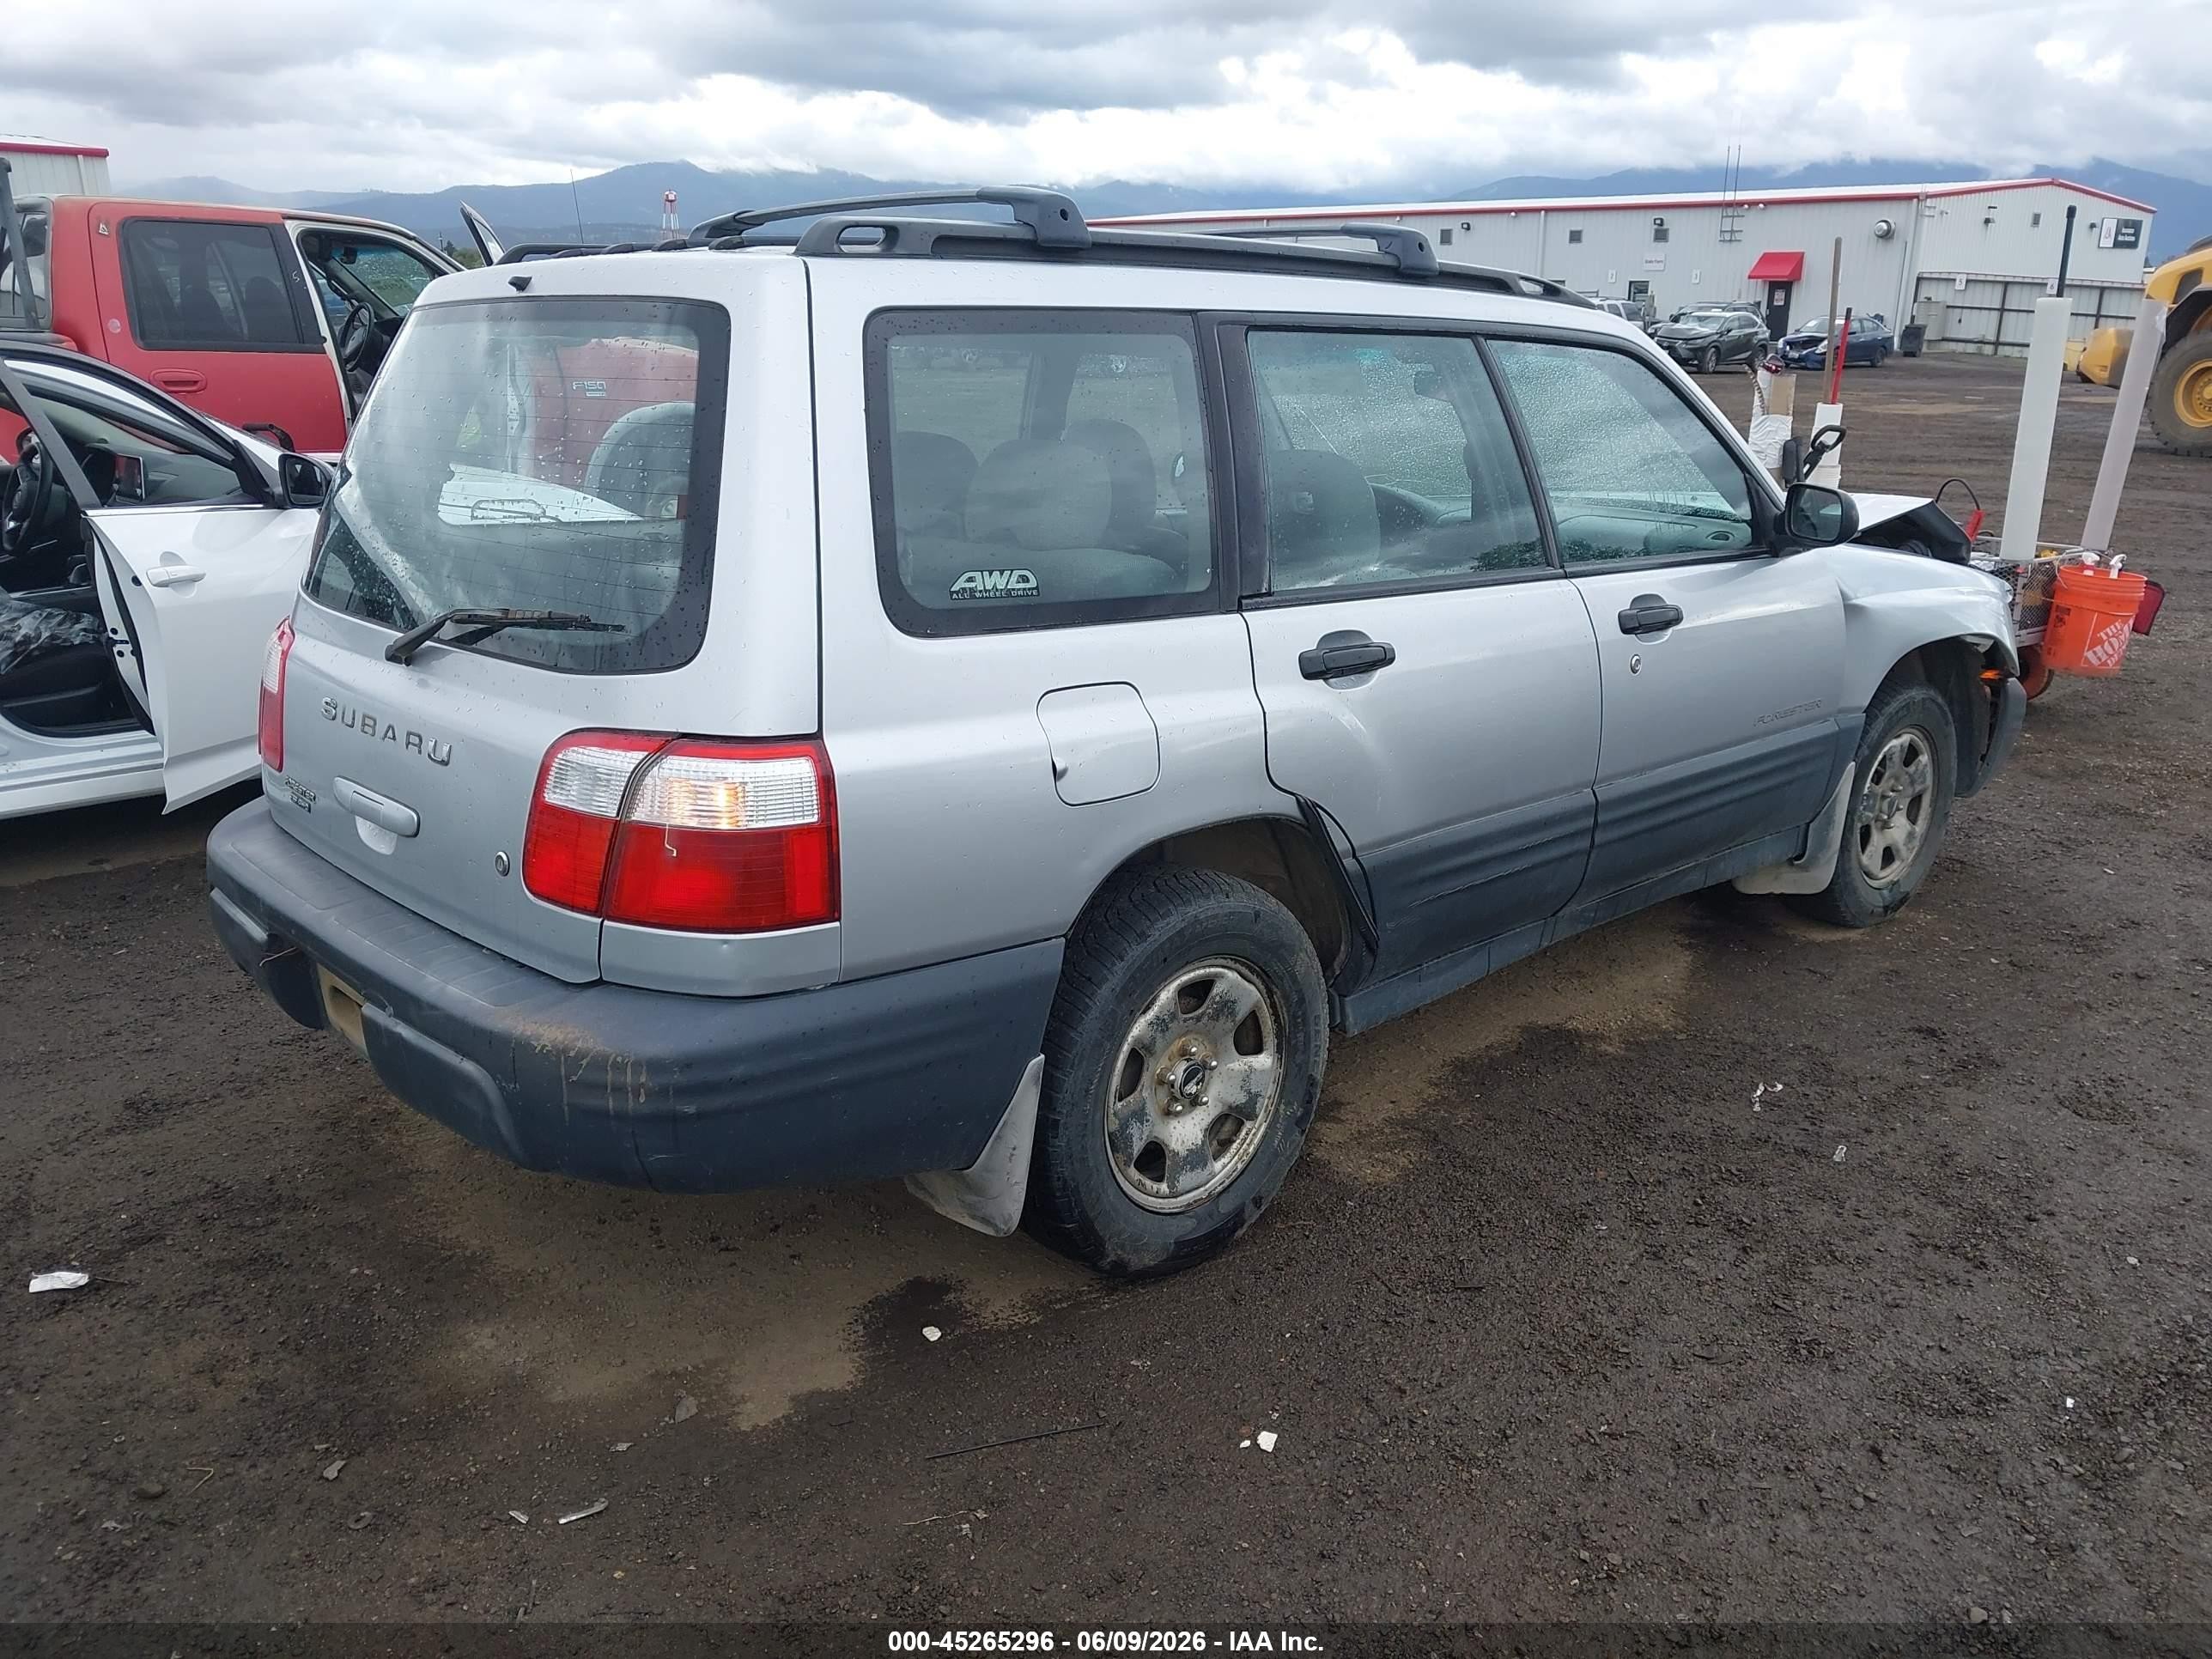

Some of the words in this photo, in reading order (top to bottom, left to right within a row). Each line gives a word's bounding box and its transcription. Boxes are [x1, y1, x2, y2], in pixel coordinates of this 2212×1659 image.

[1958, 277, 1963, 286] 5
[950, 569, 1039, 592] AWD
[2097, 619, 2123, 641] THE
[320, 696, 452, 767] SUBARU
